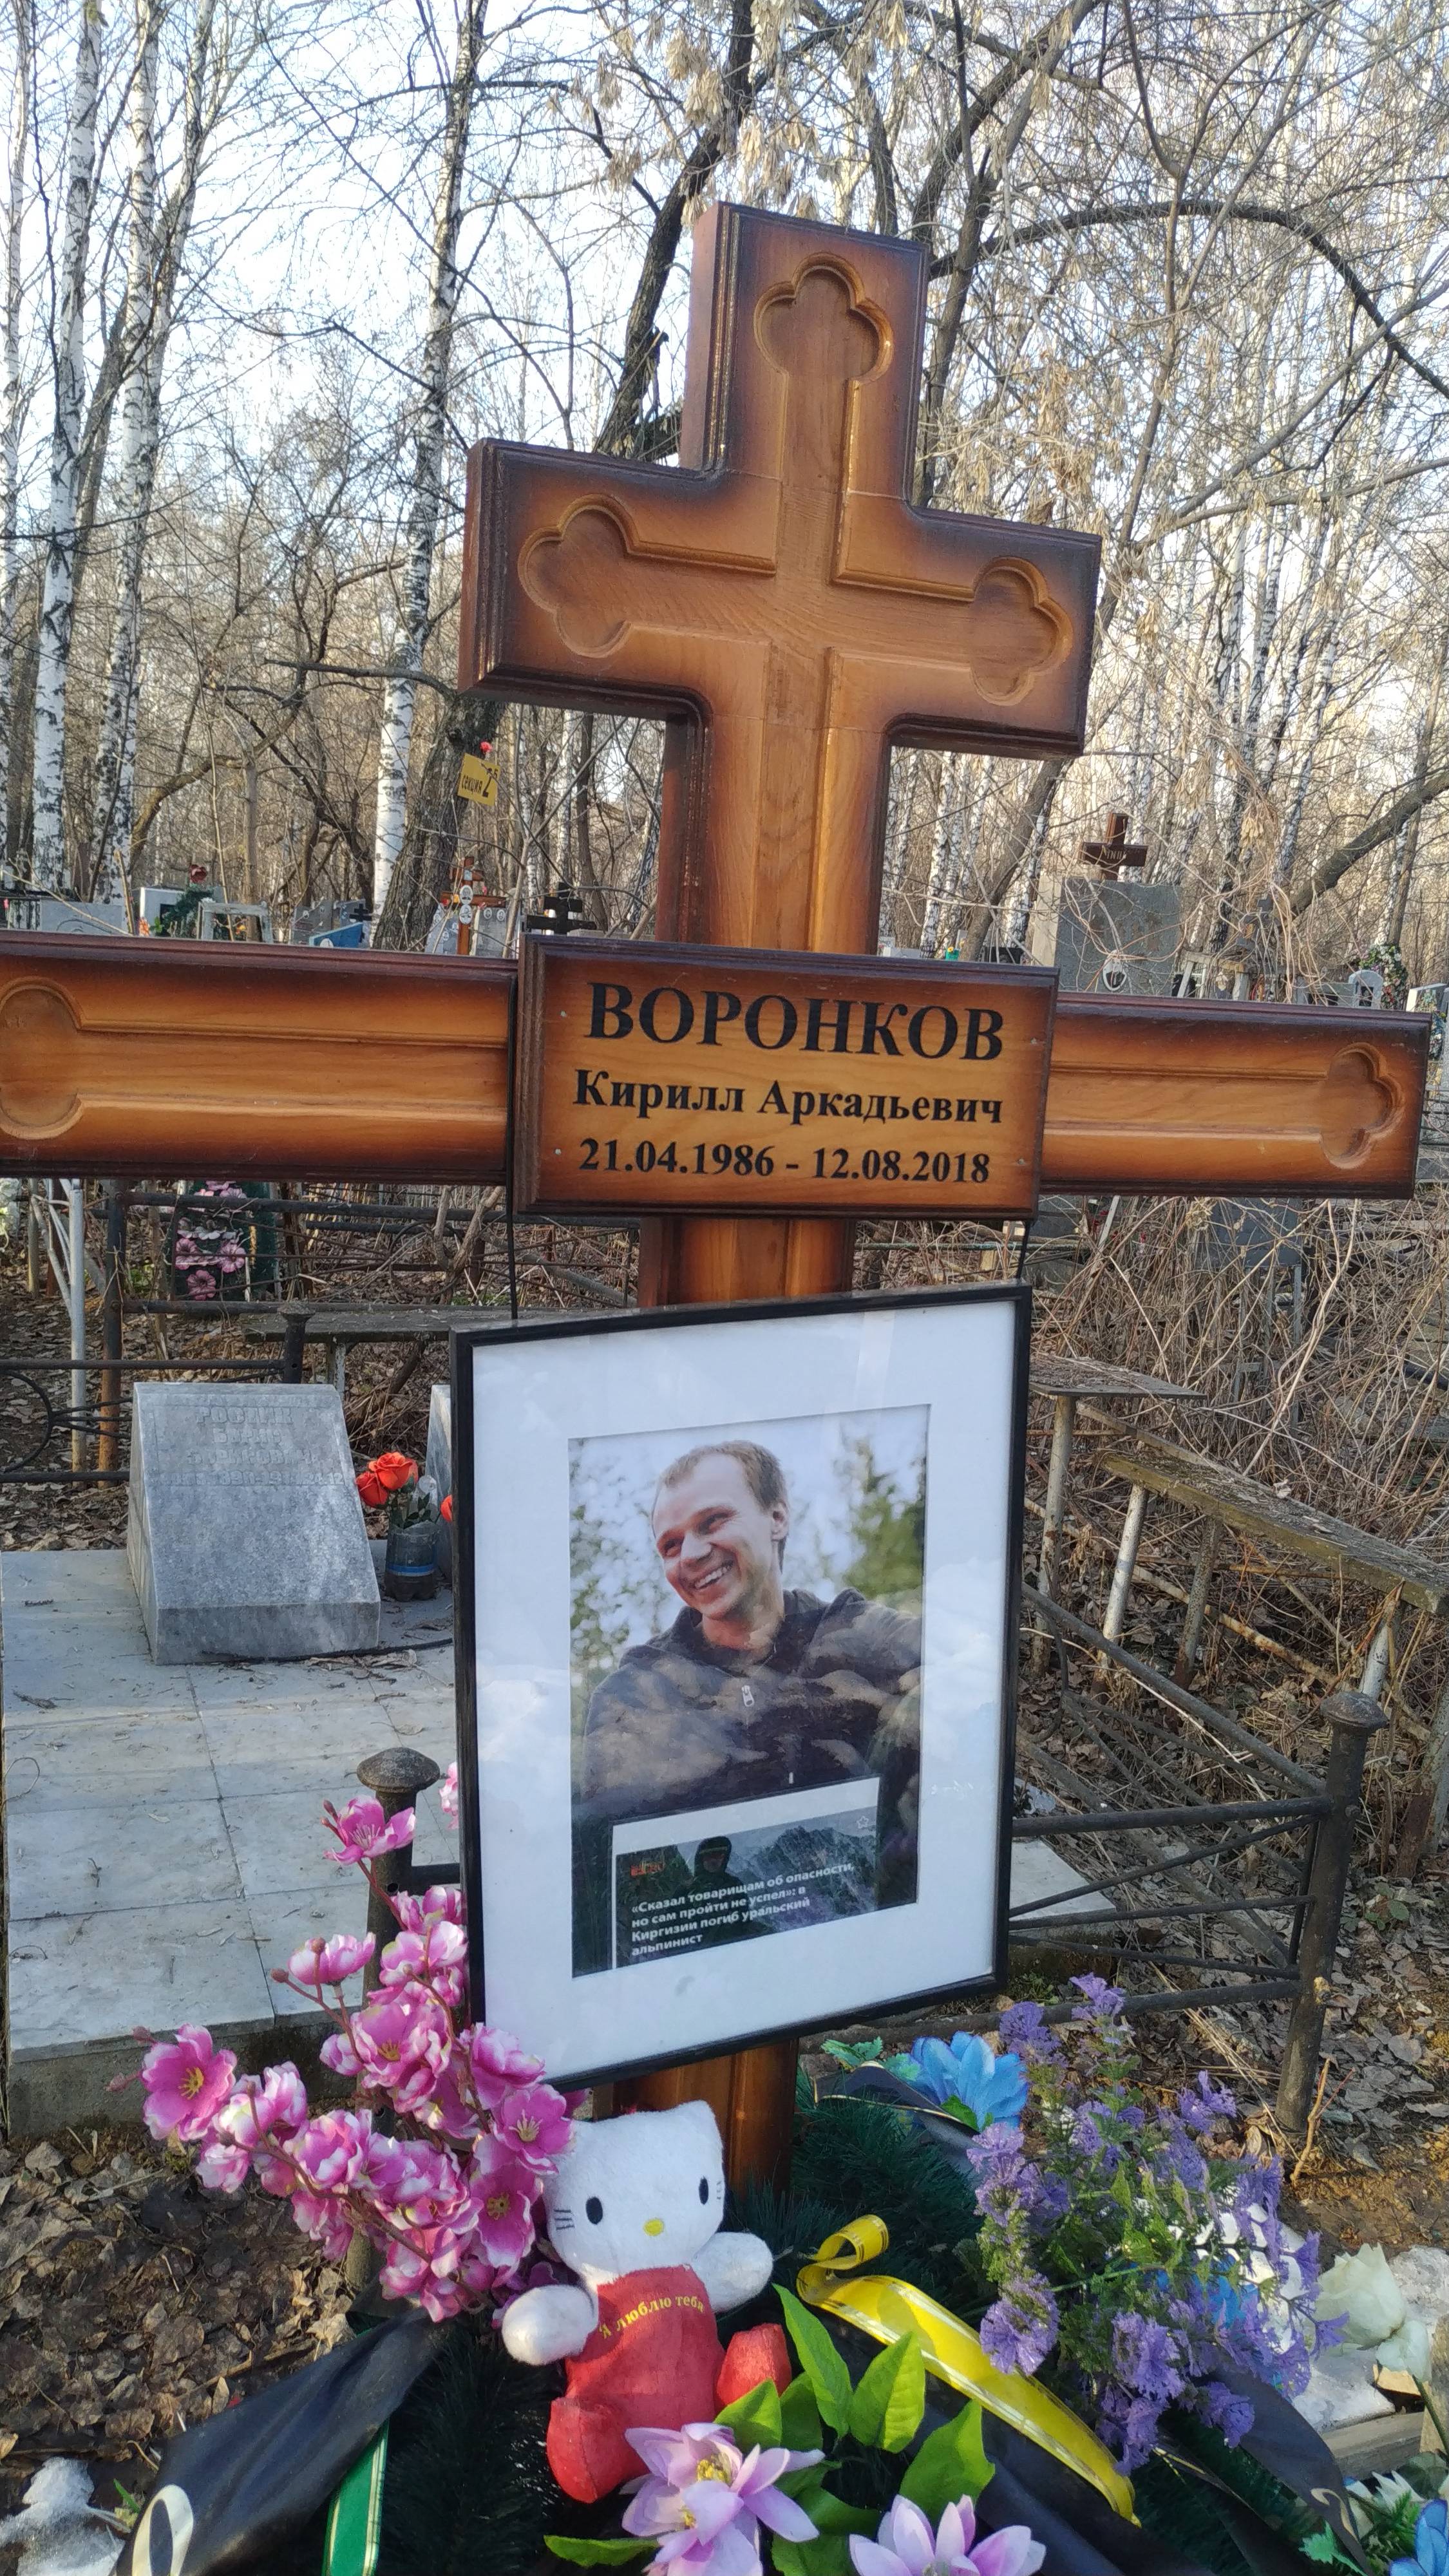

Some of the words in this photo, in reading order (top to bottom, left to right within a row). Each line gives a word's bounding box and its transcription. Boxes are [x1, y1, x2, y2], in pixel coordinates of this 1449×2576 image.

[583, 981, 1004, 1061] ВОРОНКОВ
[573, 1068, 744, 1119] Кирилл
[757, 1079, 1003, 1126] Аркадьевич
[578, 1138, 775, 1177] 21.04.1986
[812, 1146, 990, 1184] 12.08.2018
[631, 1896, 685, 1914] «Сказал
[687, 1880, 765, 1902] товарищам
[766, 1875, 784, 1888] об
[785, 1862, 855, 1883] опасности,
[632, 1917, 649, 1928] но
[651, 1912, 677, 1924] сам
[679, 1902, 728, 1919] пройти
[731, 1899, 747, 1908] не
[748, 1888, 796, 1907] успел»:
[798, 1886, 806, 1895] в
[631, 1920, 697, 1942] Киргизии
[700, 1911, 739, 1928] погиб
[741, 1896, 811, 1922] уральский
[631, 1934, 703, 1956] альпинист
[598, 2323, 612, 2340] Я
[616, 2297, 672, 2331] люблю
[676, 2295, 705, 2314] тебя
